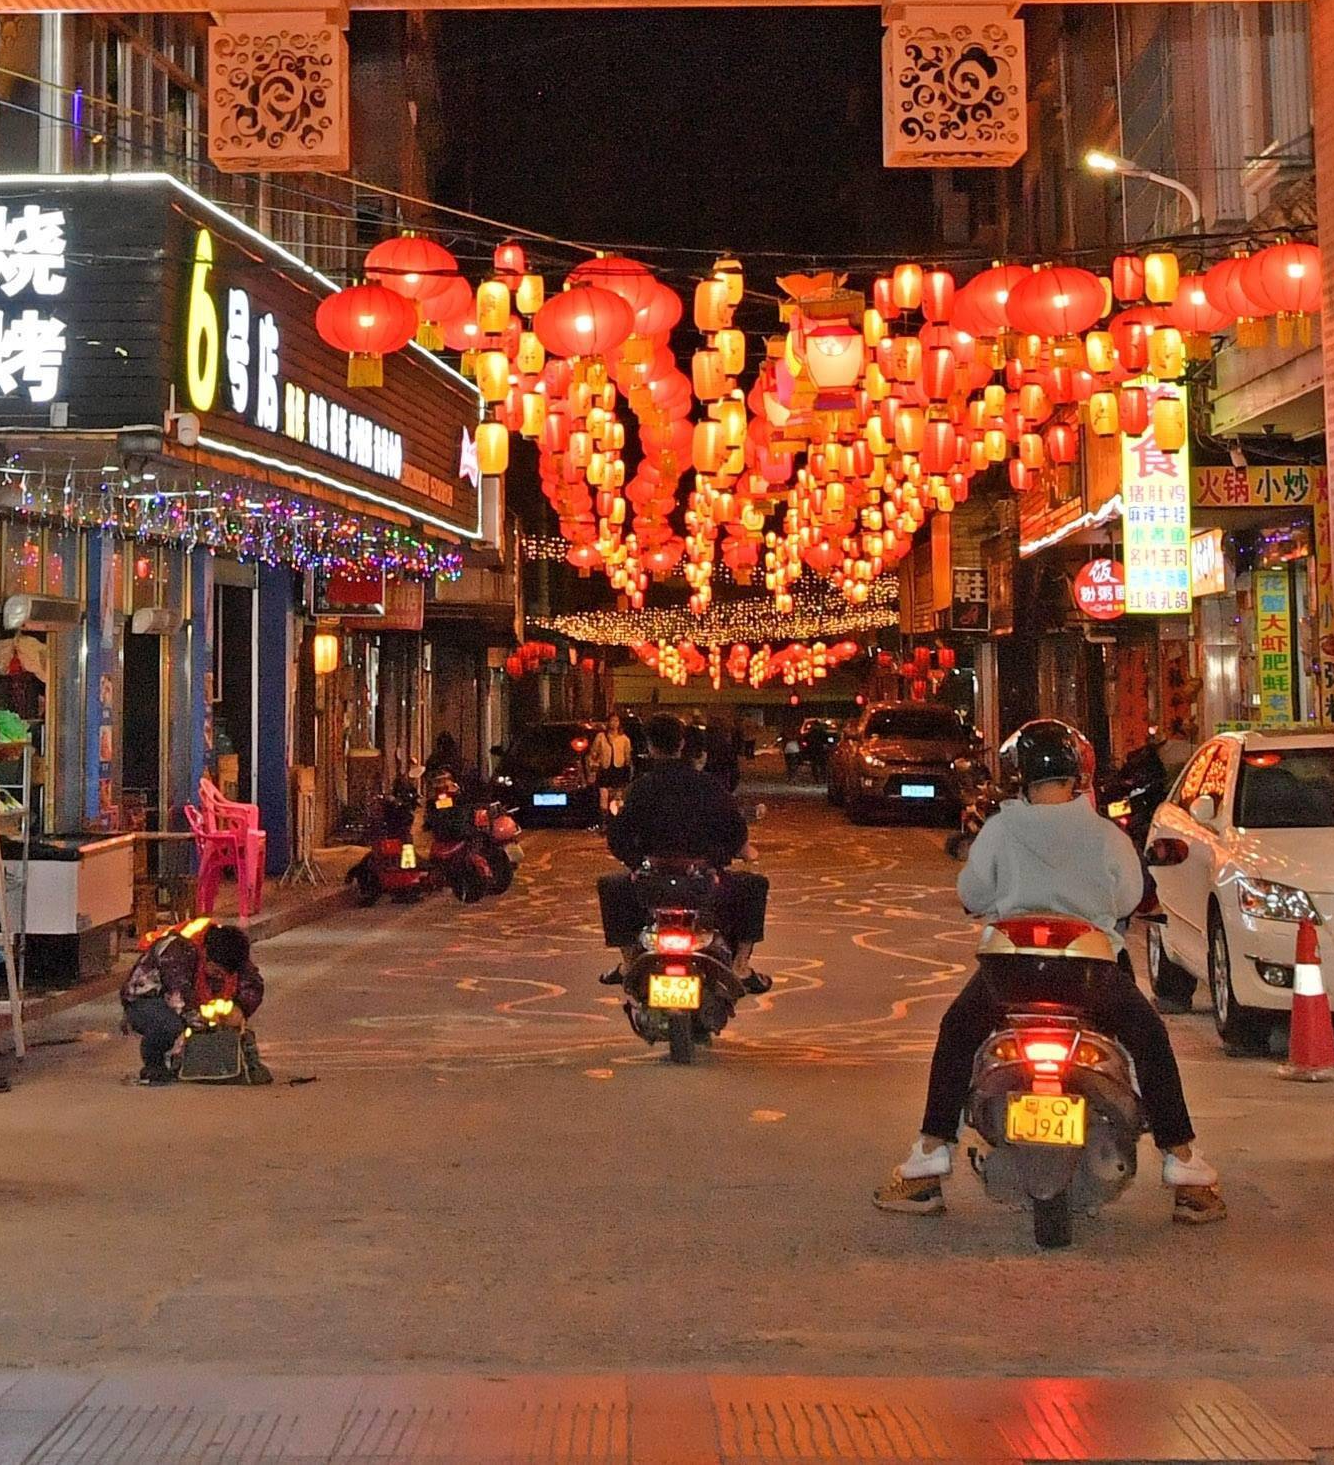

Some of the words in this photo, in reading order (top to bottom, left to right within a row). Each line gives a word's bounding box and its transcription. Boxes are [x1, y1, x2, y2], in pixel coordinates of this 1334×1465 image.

[186, 228, 280, 433] 6号店
[954, 572, 986, 603] 鞋
[1013, 1117, 1076, 1141] LJ941
